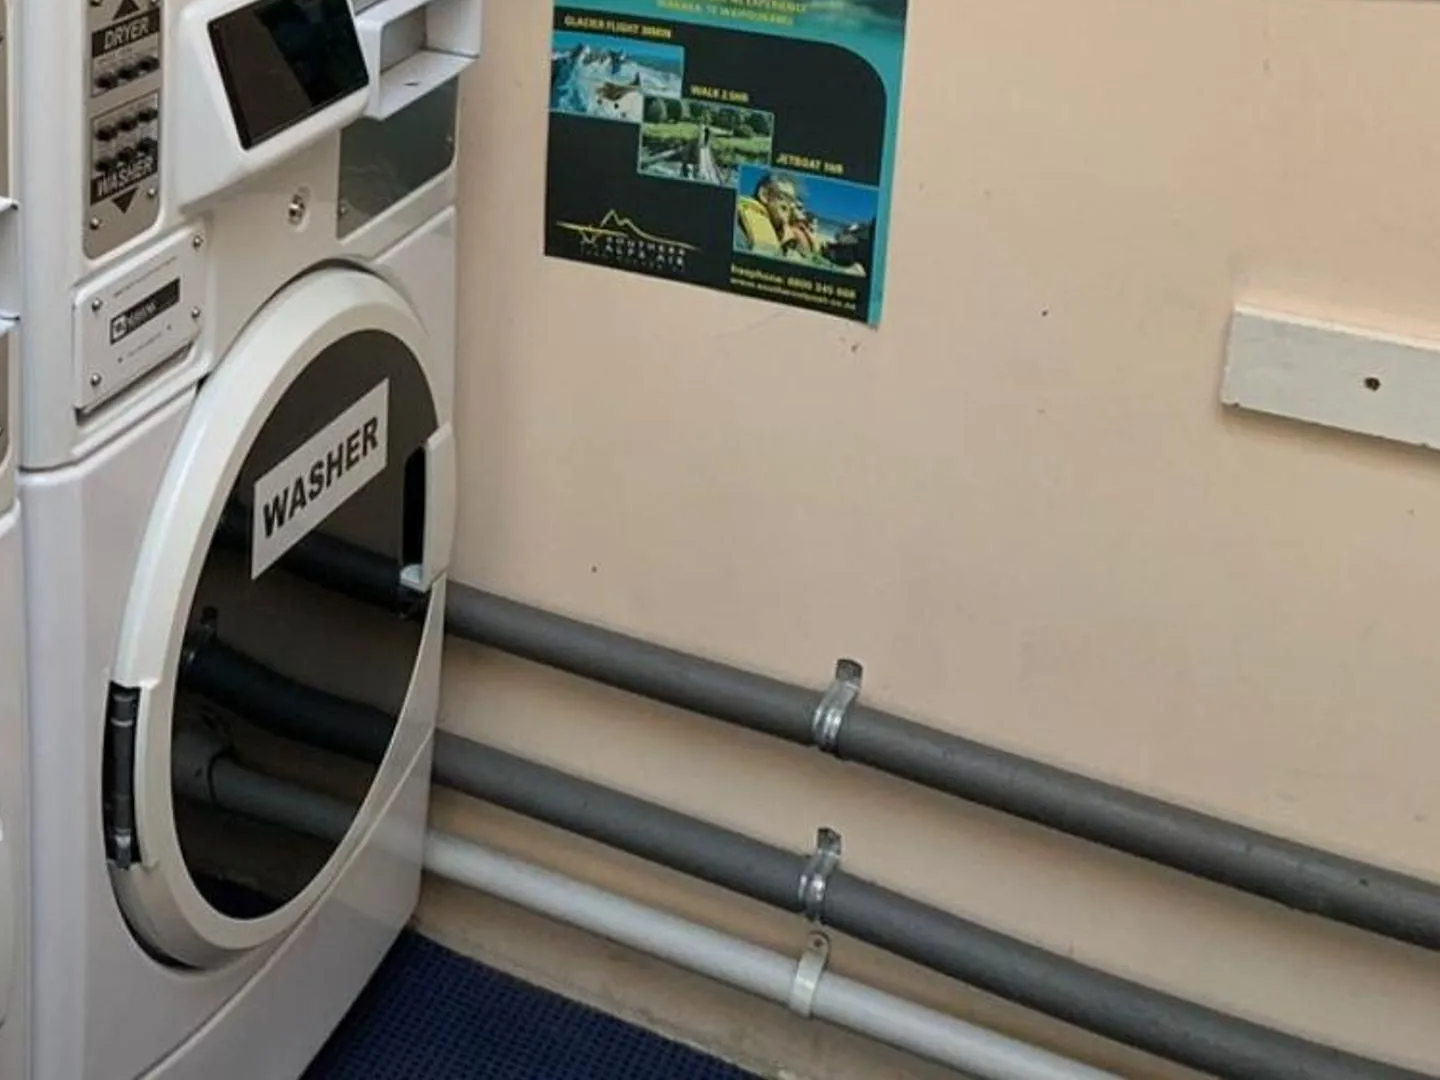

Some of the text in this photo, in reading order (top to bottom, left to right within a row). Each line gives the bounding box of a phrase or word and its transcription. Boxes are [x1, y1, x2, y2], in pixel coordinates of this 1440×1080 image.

[104, 22, 149, 49] DRYER
[97, 156, 154, 197] WASHER
[263, 416, 378, 539] WASHER
